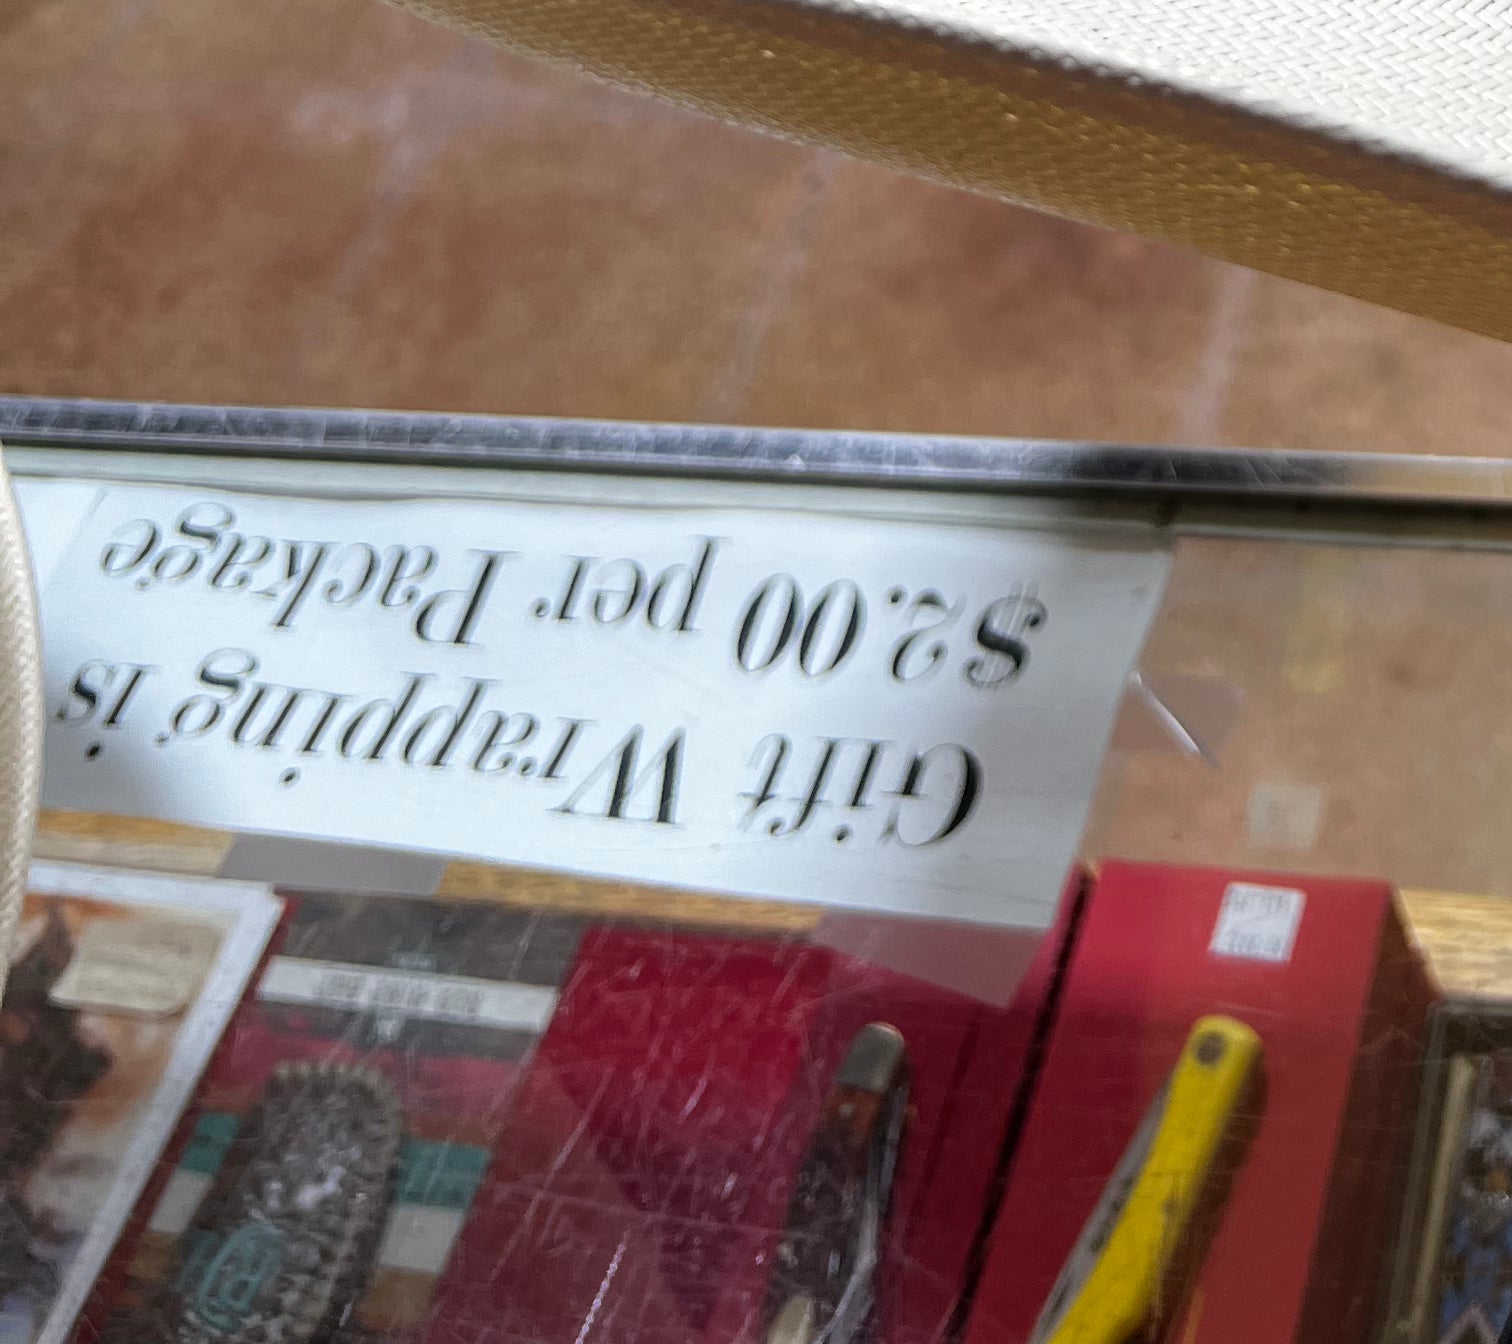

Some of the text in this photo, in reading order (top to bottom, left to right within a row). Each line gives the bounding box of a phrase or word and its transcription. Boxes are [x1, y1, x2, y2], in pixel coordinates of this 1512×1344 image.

[101, 501, 1050, 692] $2.00 per Package
[56, 647, 985, 846] Gift Wrapping is
